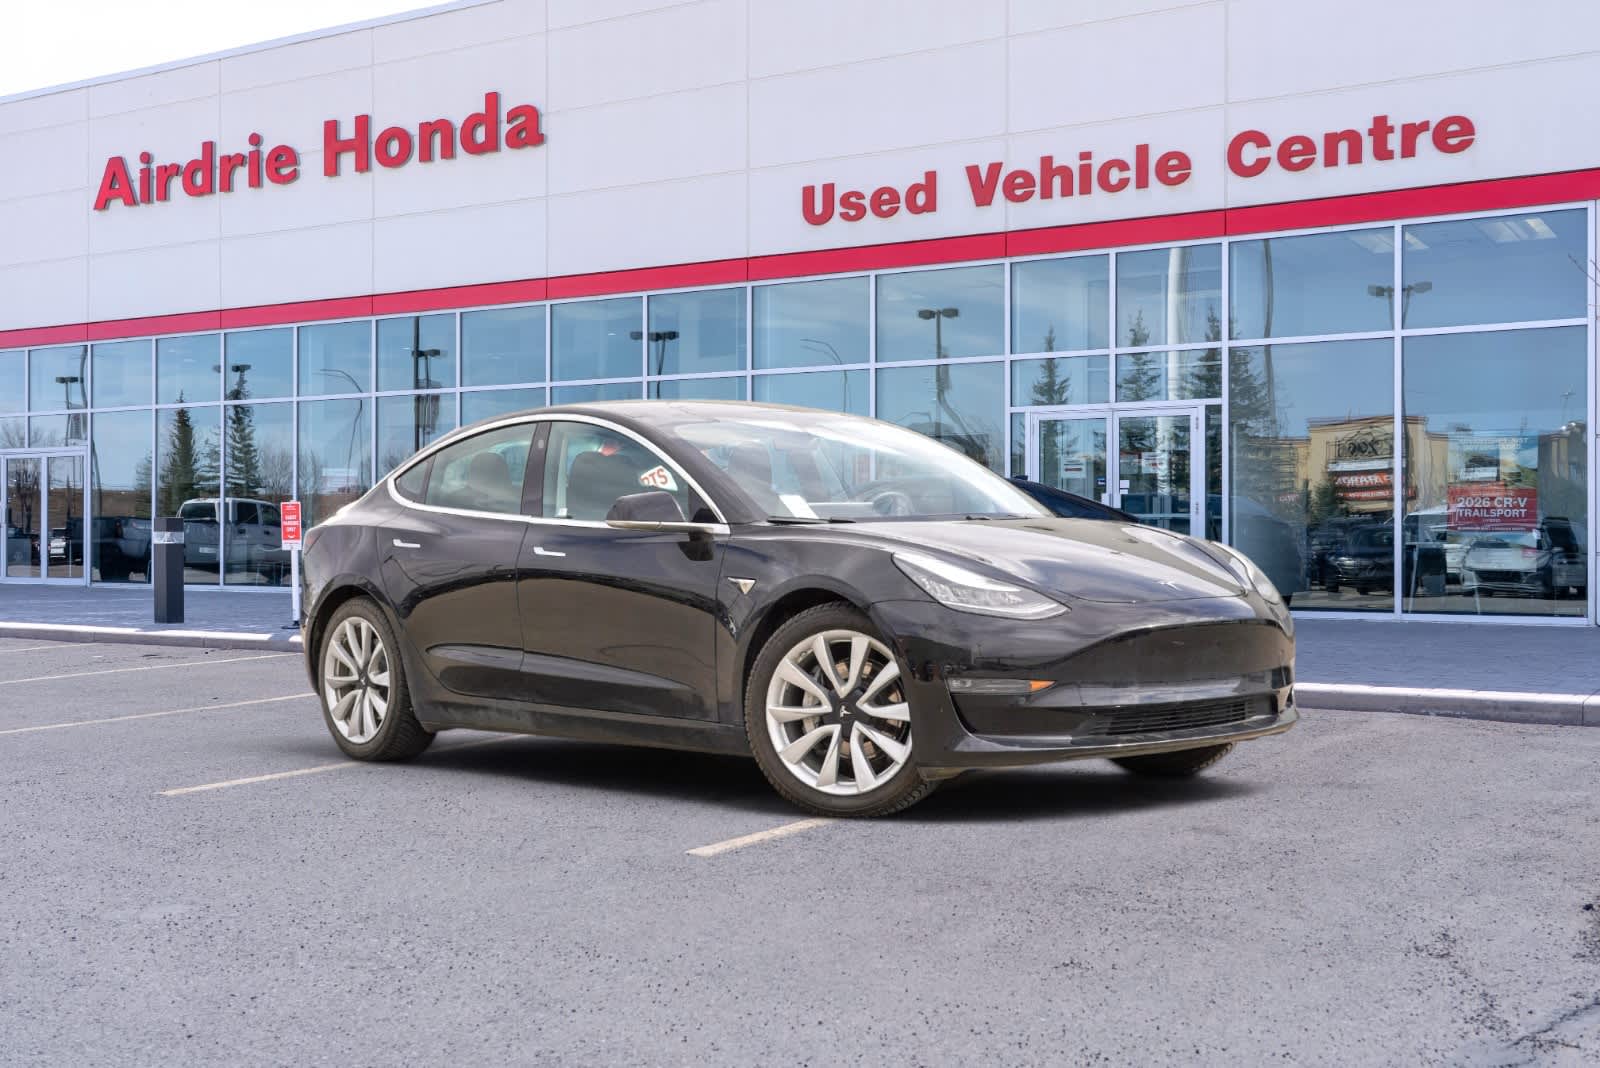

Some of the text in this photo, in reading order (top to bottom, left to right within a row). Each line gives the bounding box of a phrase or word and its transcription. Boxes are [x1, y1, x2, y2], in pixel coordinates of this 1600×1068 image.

[94, 91, 546, 211] Airdrie Honda
[802, 114, 1476, 226] Used Vehicle Centre
[1457, 497, 1528, 508] 2026 CR-V
[1457, 508, 1528, 518] TRAILSPORT
